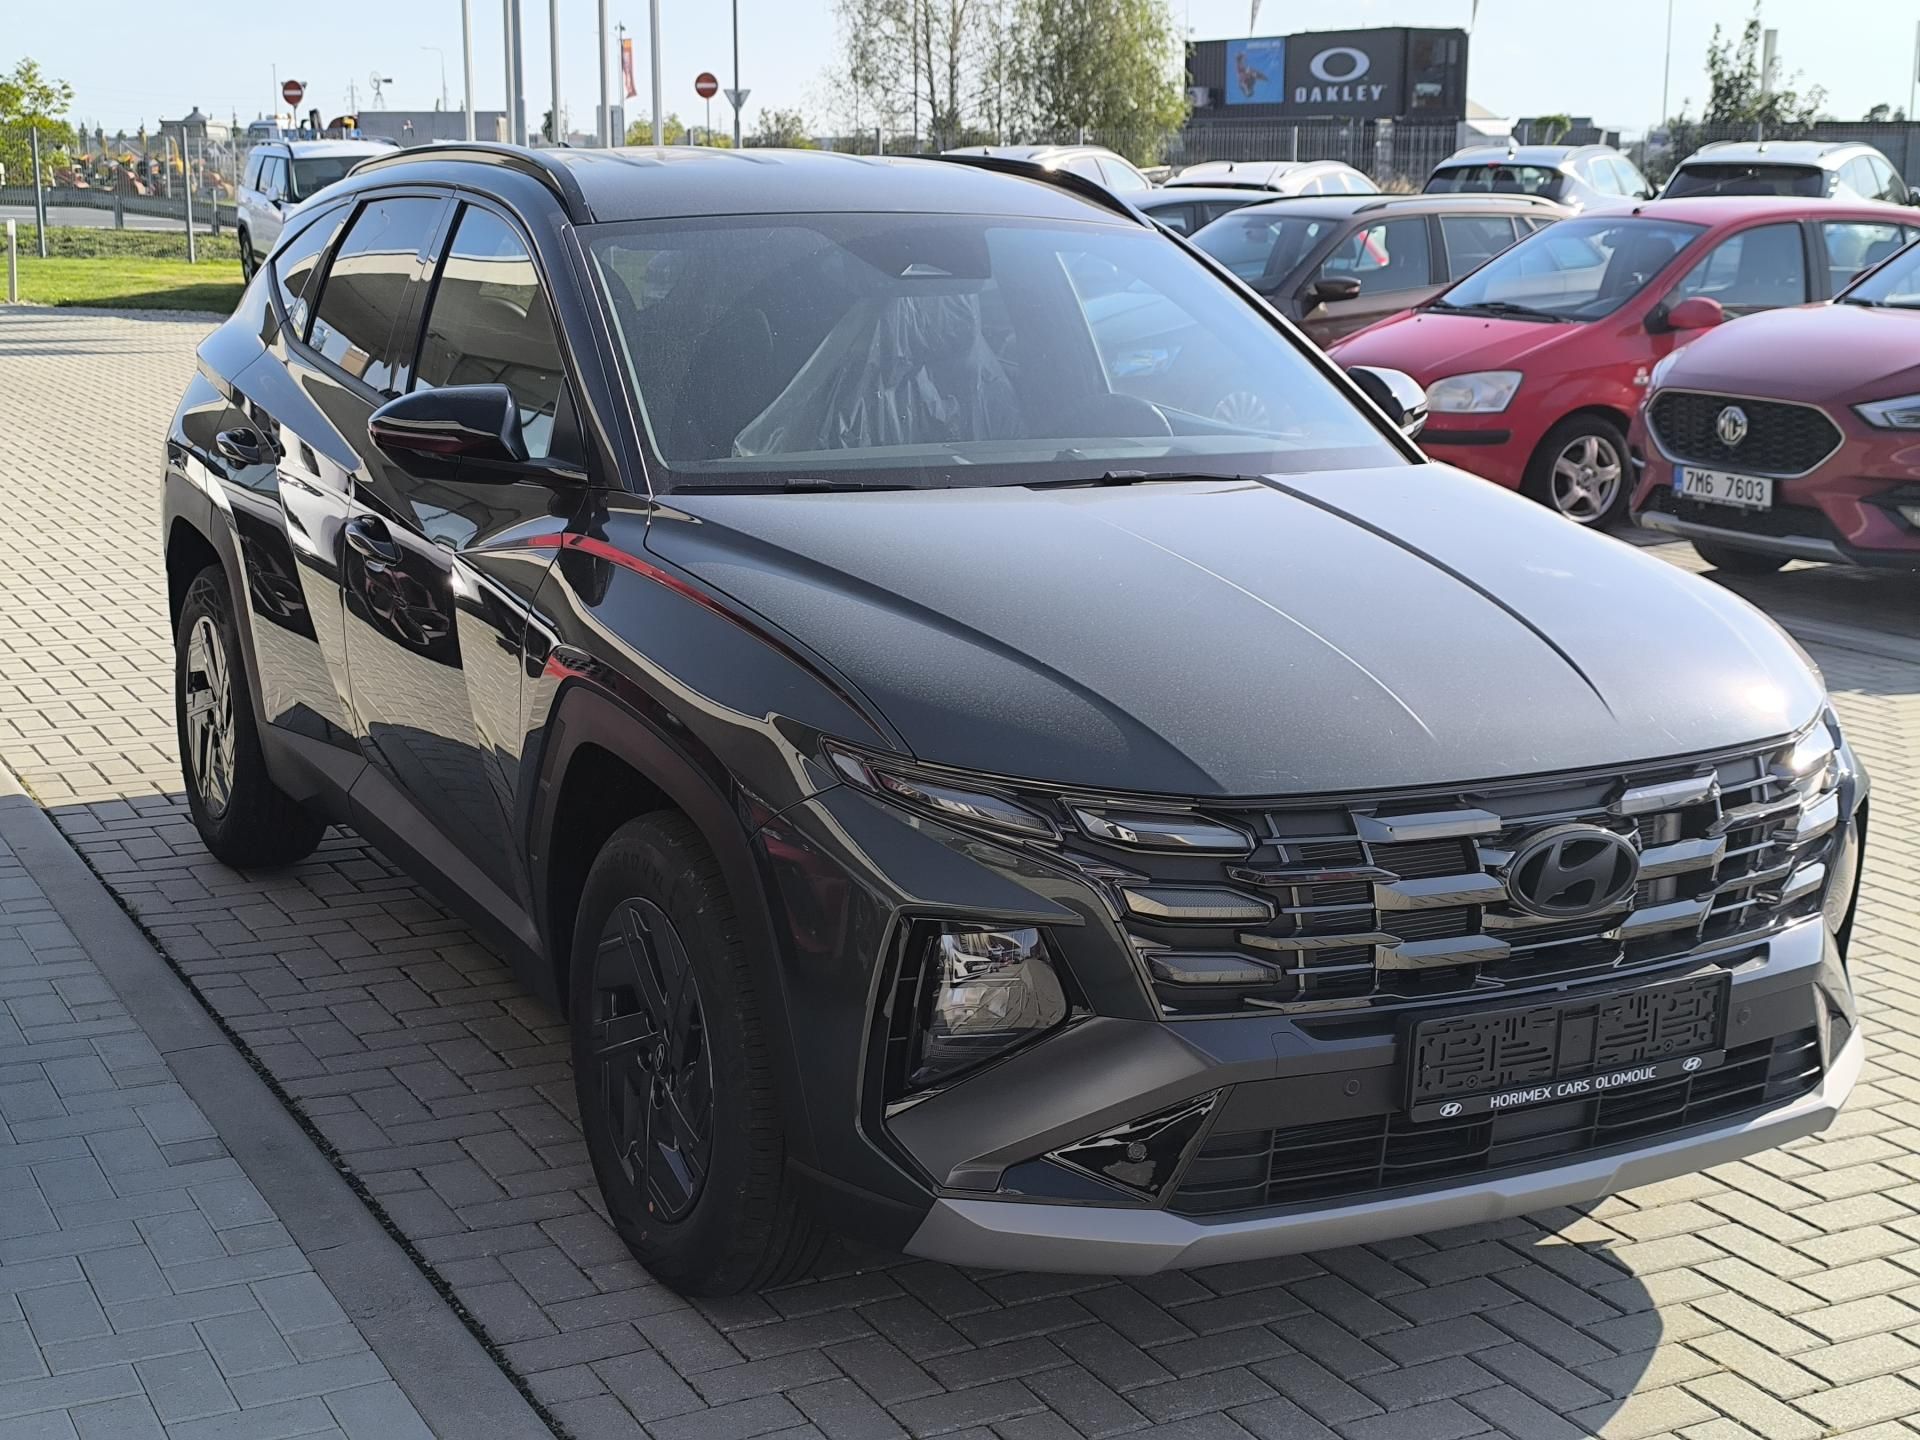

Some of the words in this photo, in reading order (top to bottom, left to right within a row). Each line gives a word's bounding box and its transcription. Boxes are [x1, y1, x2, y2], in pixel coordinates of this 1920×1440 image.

[1295, 84, 1383, 103] OAKLEY
[1718, 408, 1746, 443] MG
[1686, 471, 1714, 494] 7M6
[1725, 476, 1764, 502] 7603
[1490, 1086, 1552, 1108] HORIMEX
[1557, 1079, 1590, 1096] CARS
[1595, 1066, 1657, 1089] OLOMOUC
